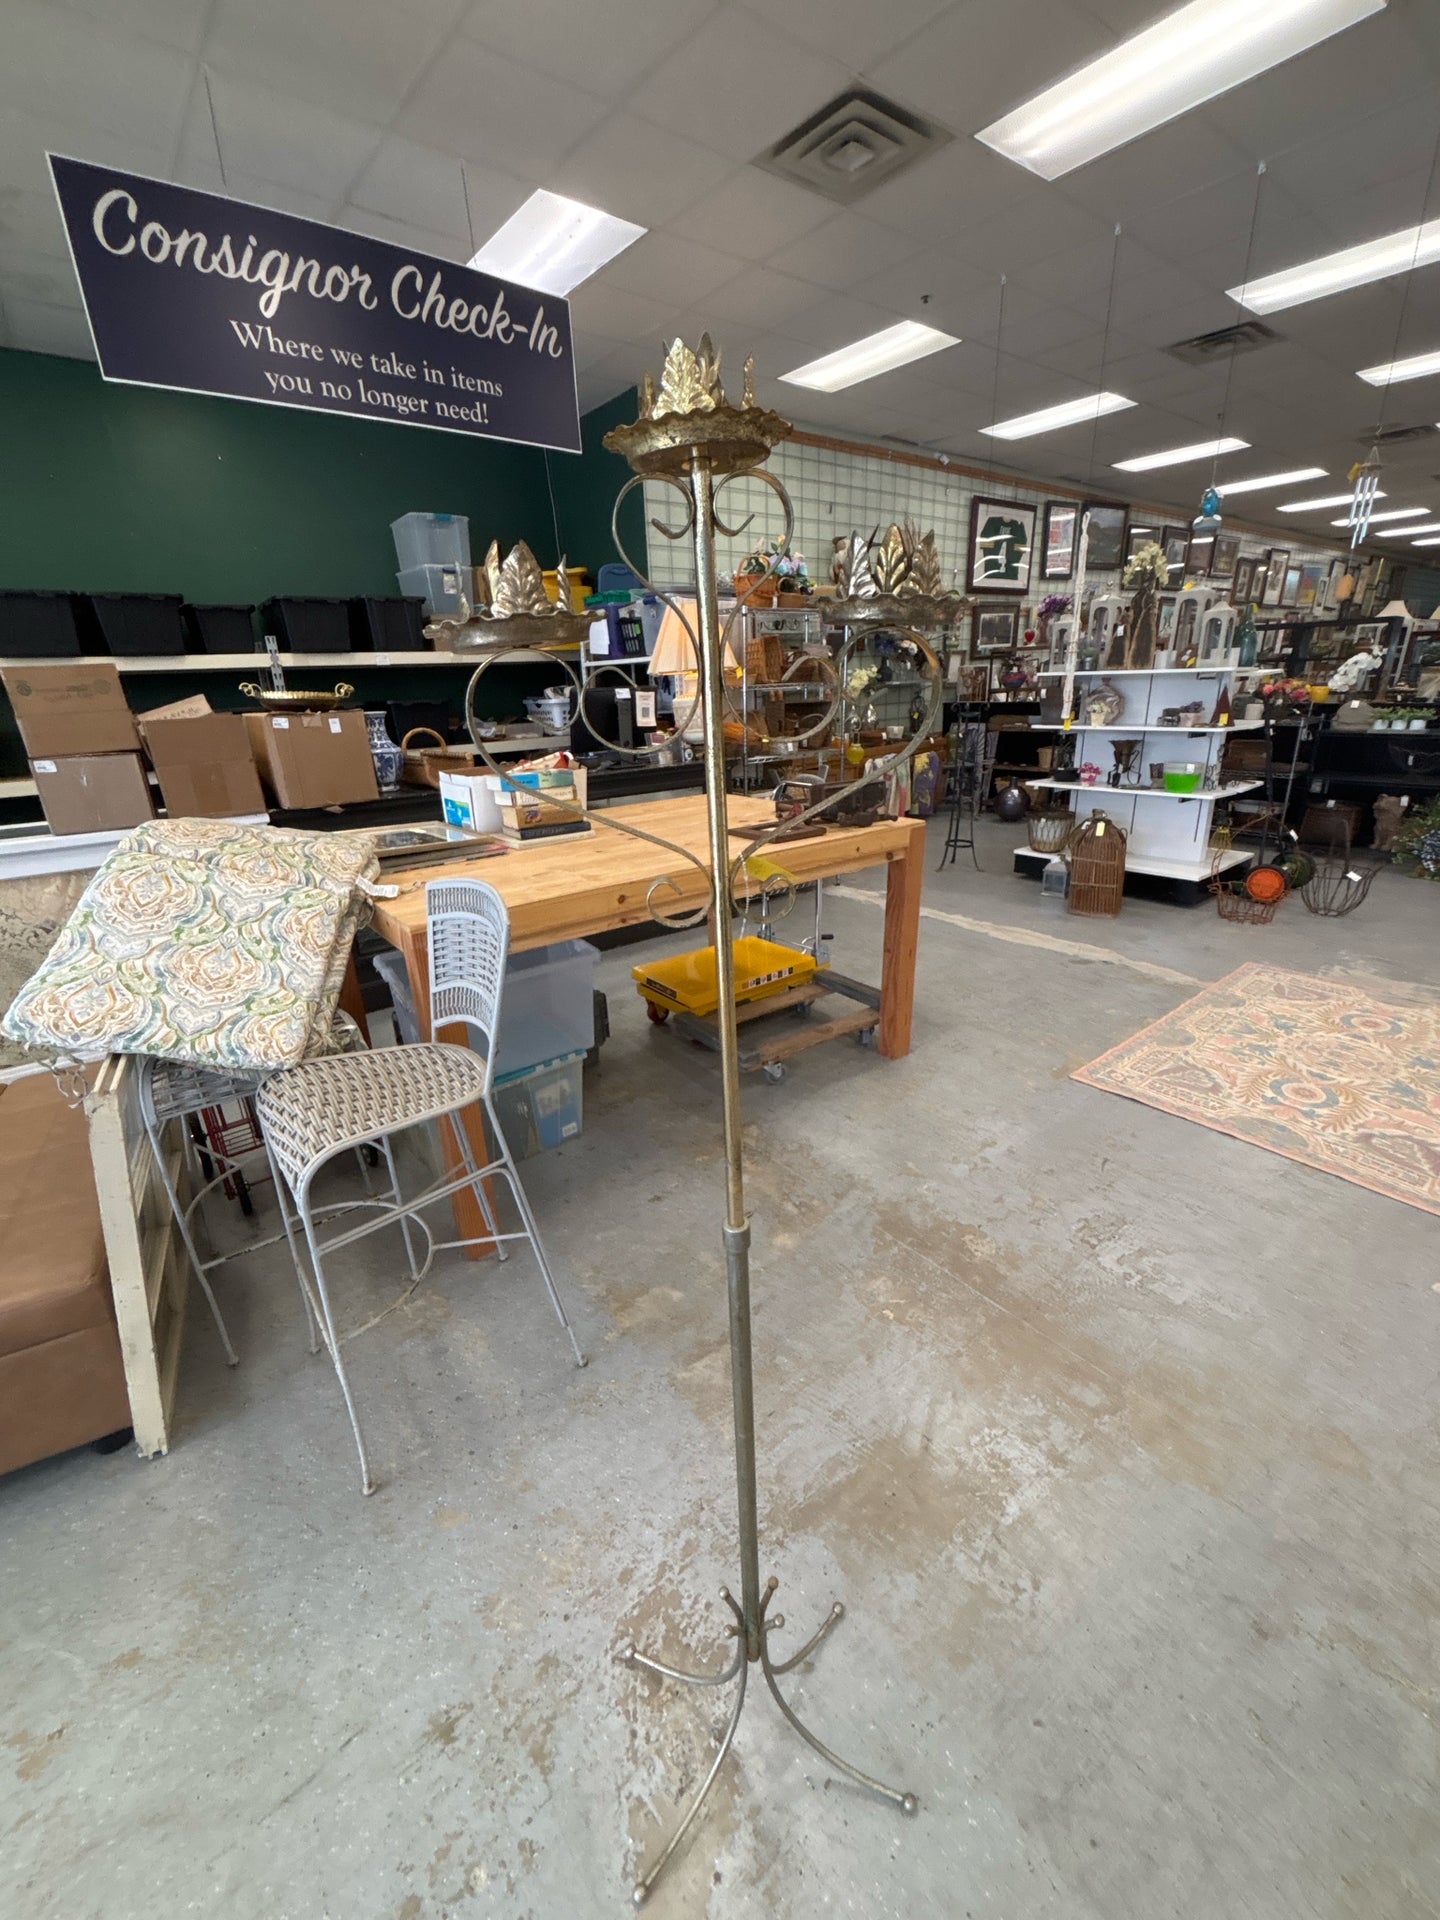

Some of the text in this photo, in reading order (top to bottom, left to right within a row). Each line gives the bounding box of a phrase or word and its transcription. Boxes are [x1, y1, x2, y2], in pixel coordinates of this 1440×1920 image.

[93, 189, 563, 359] Consignor Check-In
[229, 319, 503, 397] Where we take in items
[264, 370, 489, 425] you no longer need!
